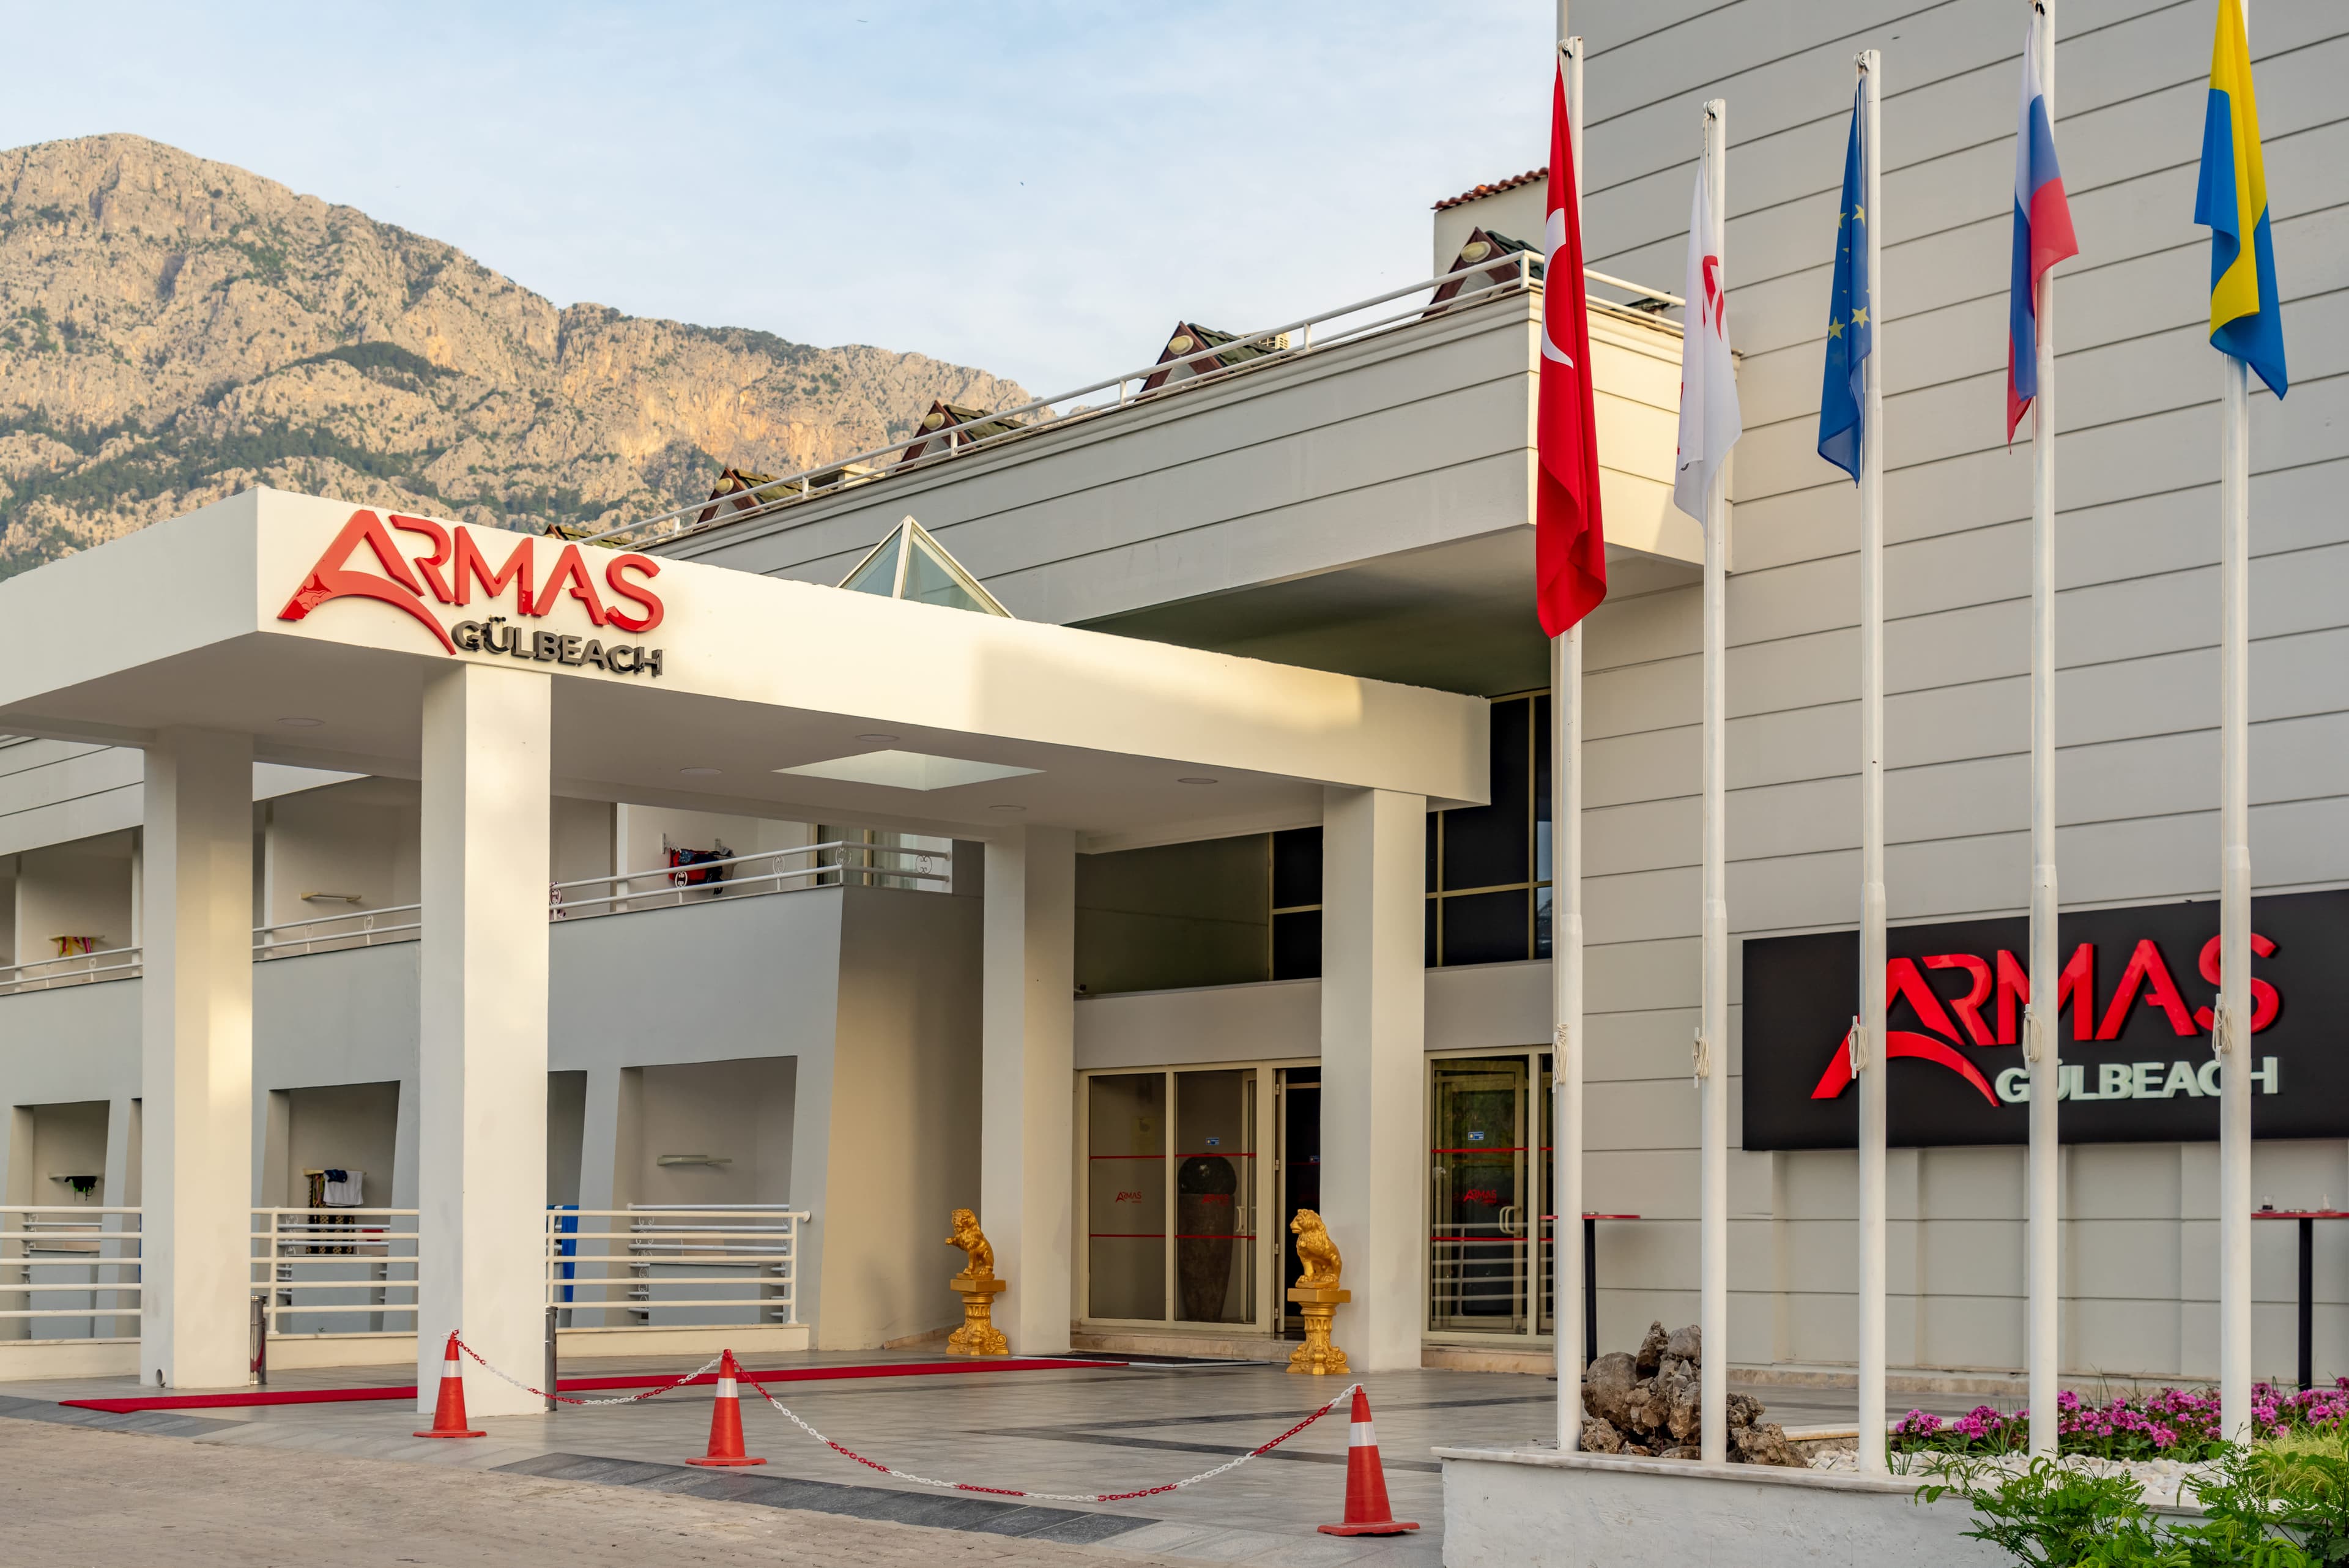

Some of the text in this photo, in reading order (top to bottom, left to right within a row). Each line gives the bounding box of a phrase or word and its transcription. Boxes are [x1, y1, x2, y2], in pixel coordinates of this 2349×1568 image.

[277, 509, 664, 655] ARMAS
[451, 615, 663, 677] GÜLBEACH
[1811, 932, 2280, 1107] ARMAS
[1115, 1191, 1142, 1204] ARMAS
